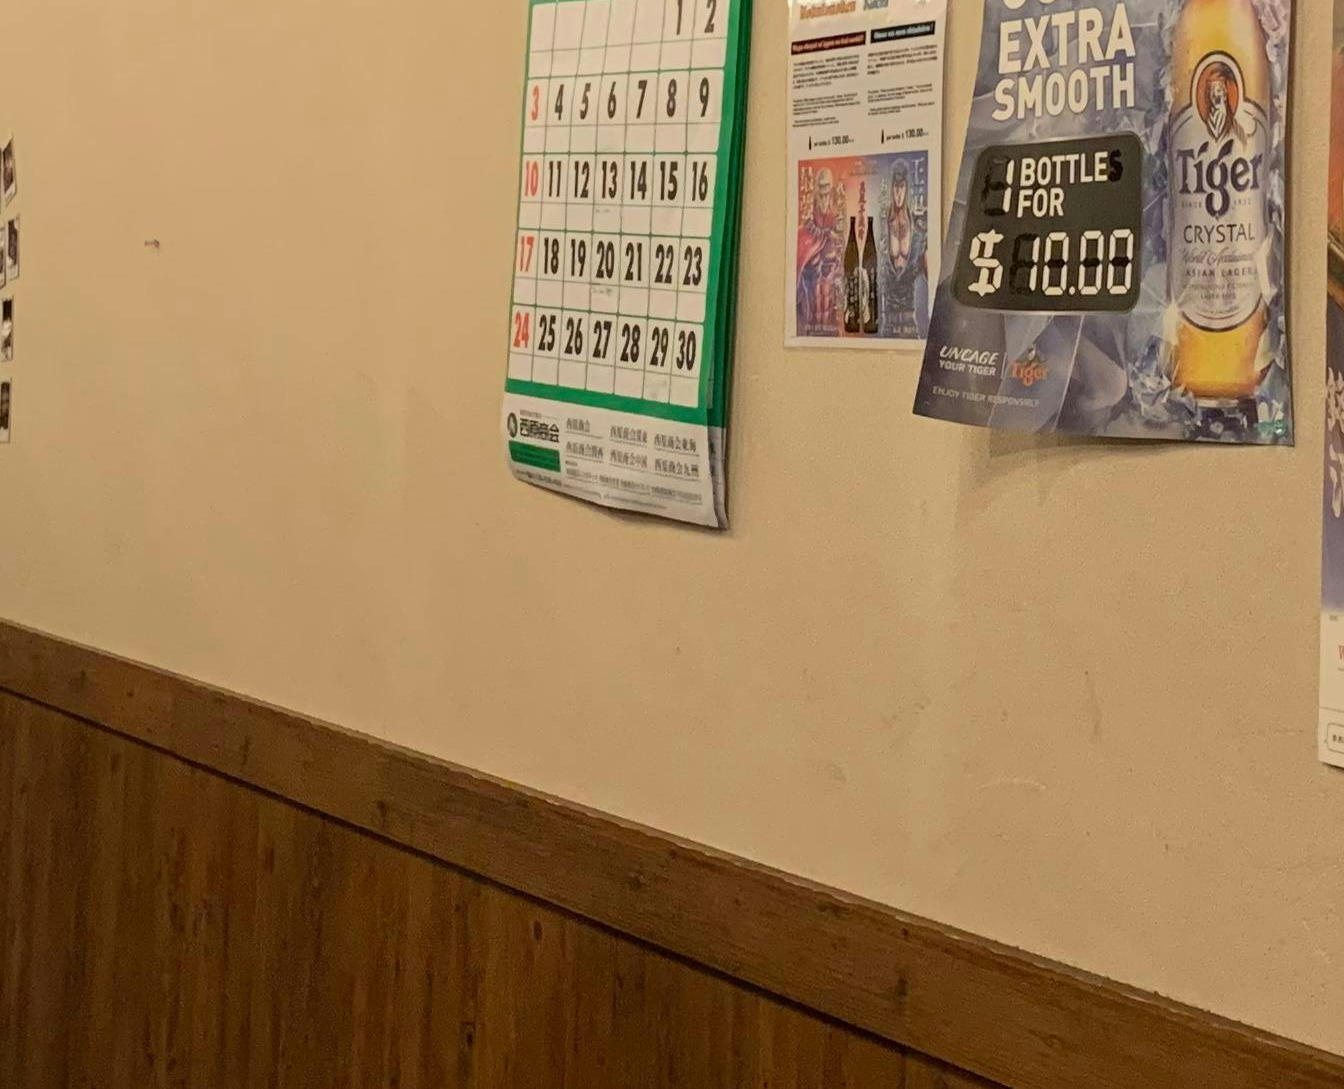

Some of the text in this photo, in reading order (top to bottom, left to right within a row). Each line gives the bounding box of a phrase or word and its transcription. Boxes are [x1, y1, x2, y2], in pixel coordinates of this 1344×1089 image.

[998, 3, 1136, 75] EXTRA
[531, 77, 710, 122] 3 4 5 6 7 8 9
[991, 63, 1135, 122] SMOOTH
[524, 161, 708, 202] 10 11 12 13 14 15 16
[1176, 139, 1263, 220] Tiger
[1017, 188, 1065, 218] FOR
[1183, 223, 1256, 244] CRYSTAL
[519, 235, 703, 286] 17 18 19 20 21 22 23
[513, 312, 696, 371] 24 25 26 27 28 29 30
[939, 345, 1000, 366] UNCAGE
[939, 359, 997, 377] YOUR TIGER
[1010, 357, 1049, 387] Tiger
